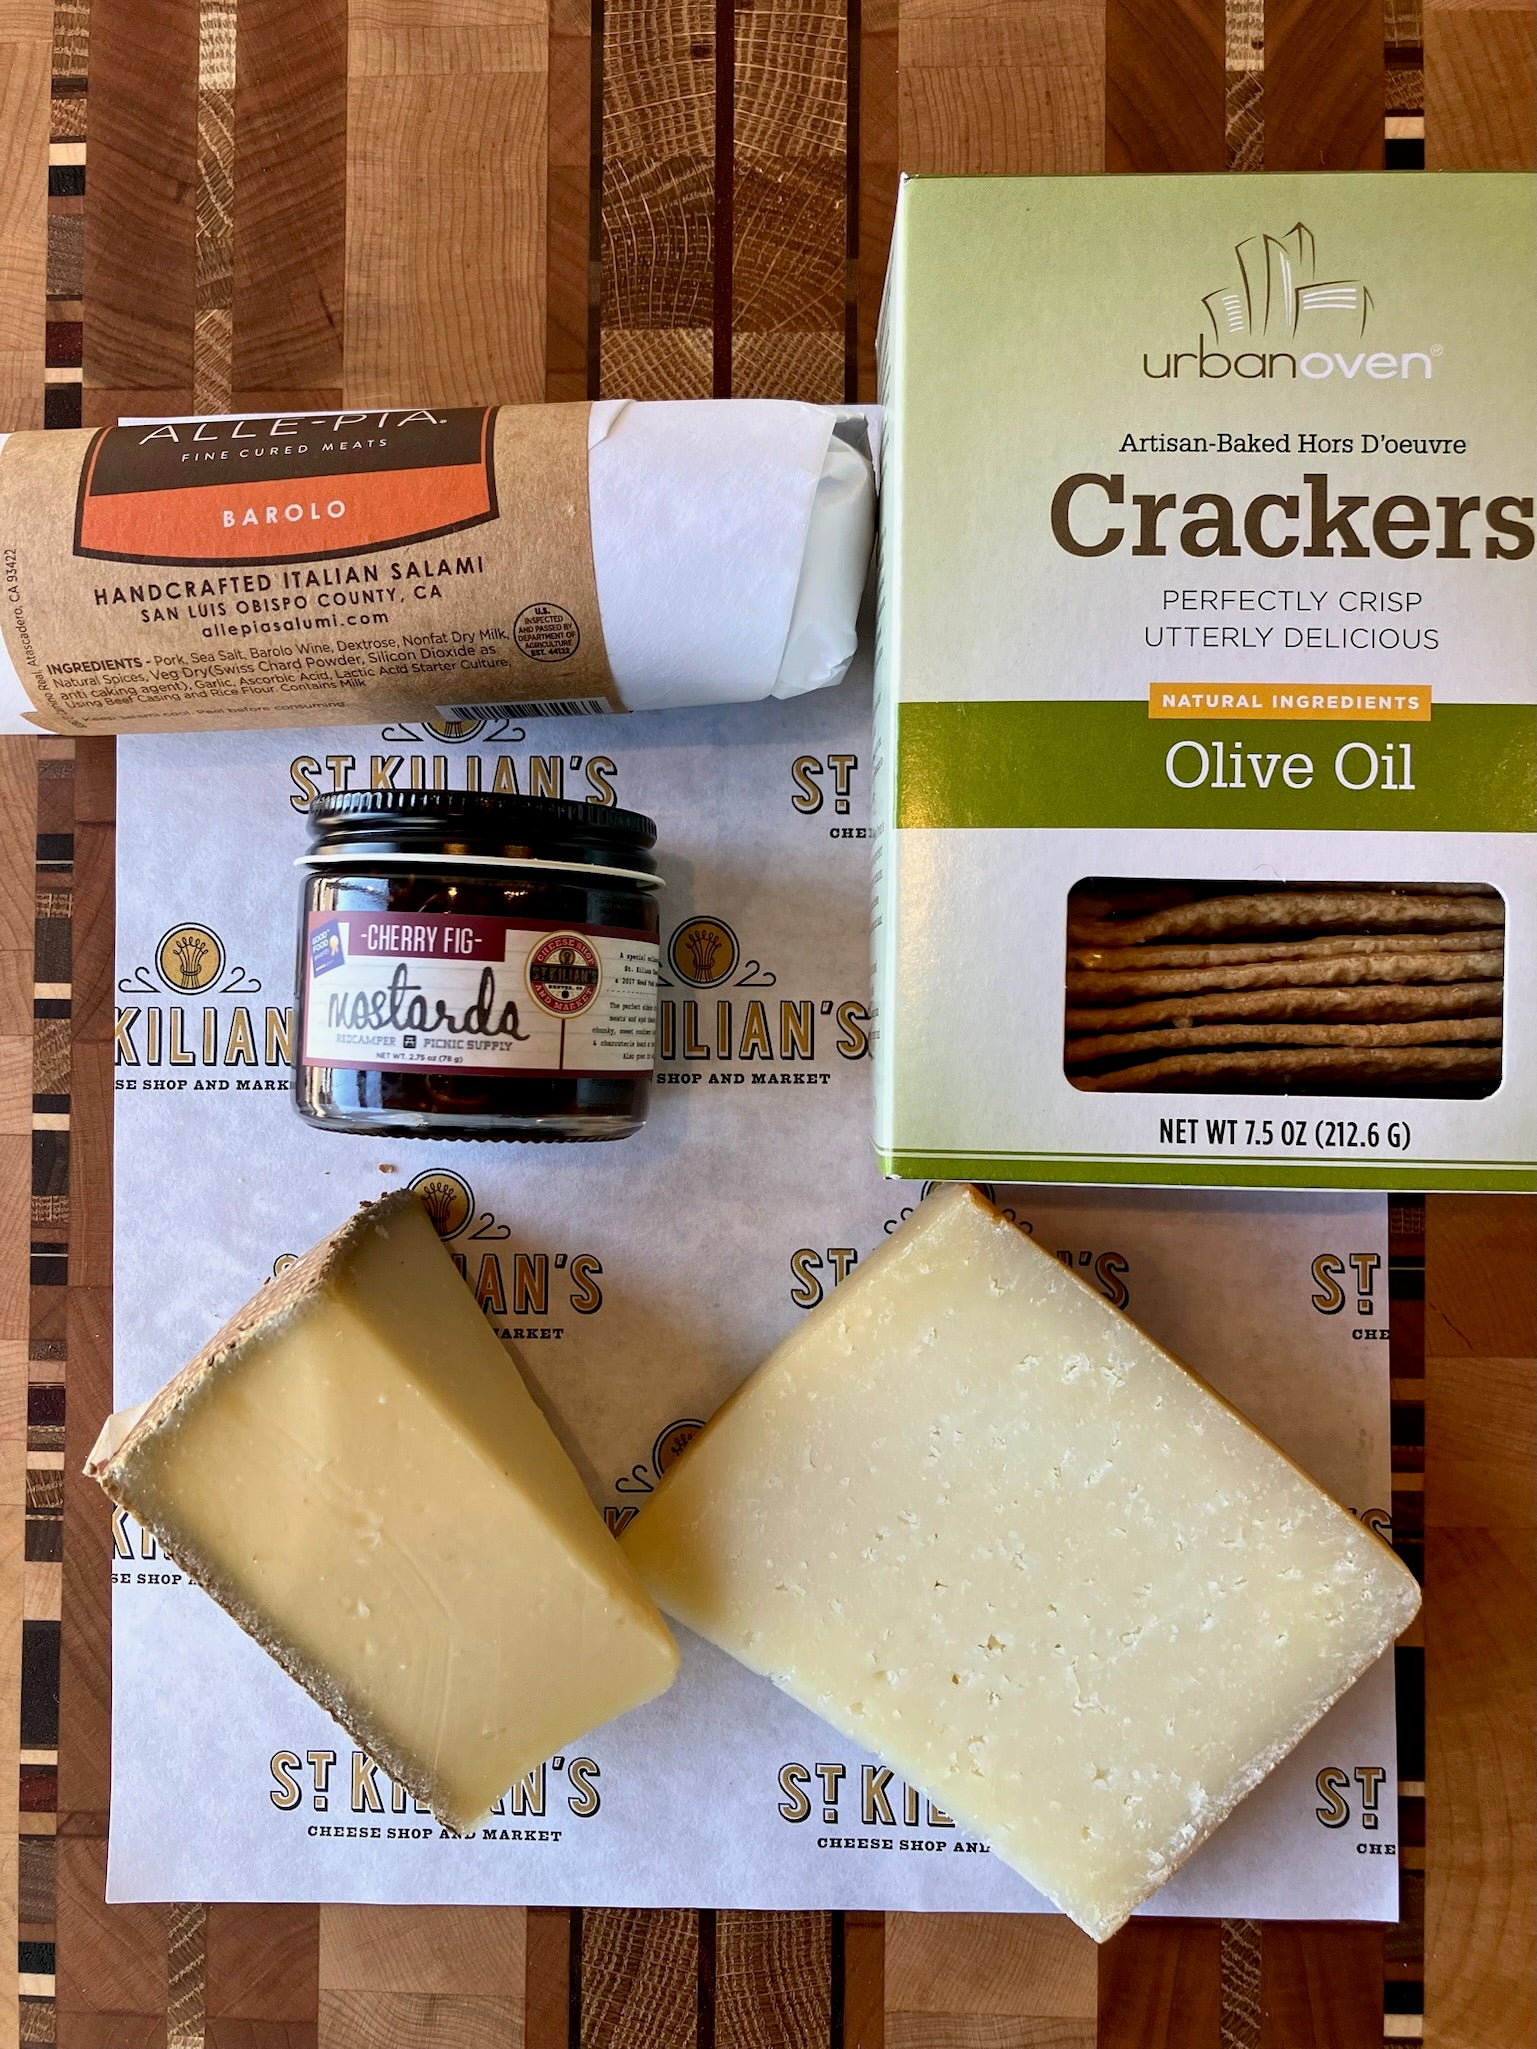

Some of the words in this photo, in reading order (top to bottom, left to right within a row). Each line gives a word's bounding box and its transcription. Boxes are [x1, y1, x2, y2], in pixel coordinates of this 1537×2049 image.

[181, 450, 229, 463] FINE
[239, 444, 309, 459] CURED
[321, 438, 388, 452] MEATS
[1119, 433, 1290, 454] Artisan-Baked
[1298, 434, 1353, 454] Hors
[1361, 435, 1466, 455] D'oeuvre
[223, 500, 346, 528] BAROLO
[1050, 472, 1536, 560] Crackers
[4, 549, 17, 582] 93422
[94, 574, 271, 606] HANDCRAFTED
[283, 564, 378, 589] ITALIAN
[391, 556, 484, 580] SALAMI
[8, 586, 20, 602] CA
[141, 606, 179, 623] SAN
[188, 603, 227, 619] LUIS
[236, 595, 307, 614] OBISPO
[317, 588, 405, 607] COUNTY,
[414, 585, 442, 600] CA
[1163, 590, 1328, 612] PERFECTLY
[1339, 591, 1422, 613] CRISP
[202, 612, 389, 638] allepiasalumi.com
[525, 615, 563, 624] INSPECTED
[535, 624, 561, 632] PASSED
[518, 632, 564, 641] DEPARTMENT
[1145, 626, 1273, 648] UTTERLY
[1285, 627, 1439, 650] DELICIOUS
[46, 657, 143, 675] INGREDIENTS
[153, 654, 189, 667] Pork,
[190, 652, 215, 664] Sea
[219, 649, 247, 661] Salt,
[250, 645, 293, 659] Barolo
[295, 642, 334, 655] Wine,
[336, 638, 400, 652] Dextrose,
[402, 632, 448, 647] Nonfat
[452, 631, 475, 644] Dry
[52, 676, 100, 689] Natural
[102, 672, 149, 687] Spices,
[150, 669, 179, 682] Veg
[258, 658, 303, 672] Chard
[305, 653, 365, 669] Powder,
[369, 650, 416, 664] Silicon
[420, 645, 475, 660] Dioxide
[480, 645, 497, 655] as
[61, 689, 87, 701] anti
[90, 685, 137, 699] caking
[141, 681, 193, 696] agent),
[239, 673, 296, 686] Ascorbic
[300, 670, 333, 682] Acid,
[334, 666, 375, 680] Lactic
[412, 661, 456, 673] Starter
[65, 698, 103, 710] Using
[105, 694, 134, 706] Beef
[137, 692, 180, 704] Casing
[184, 689, 207, 700] and
[211, 687, 239, 697] Rice
[280, 680, 338, 693] Contains
[340, 677, 367, 688] Milk
[1162, 694, 1263, 709] NATURAL
[1272, 695, 1420, 711] INGREDIENTS
[1165, 740, 1314, 789] Olive
[1334, 742, 1416, 791] Oil
[537, 939, 575, 962] CHEESE
[424, 1037, 465, 1050] PICNIC
[467, 1039, 514, 1052] SUPPLY
[377, 1052, 390, 1060] NET
[409, 1053, 425, 1062] 2.75
[143, 1080, 188, 1090] SHOP
[194, 1080, 230, 1090] AND
[657, 1073, 703, 1085] SHOP
[709, 1073, 745, 1085] AND
[752, 1073, 831, 1085] MARKET
[1160, 1118, 1198, 1144] NET
[1206, 1119, 1238, 1145] WT
[1245, 1119, 1274, 1146] 7.5
[1280, 1120, 1308, 1147] OZ
[1315, 1120, 1380, 1150] (212.6
[1387, 1121, 1412, 1151] G)
[137, 1573, 182, 1585] SHOP
[308, 1825, 381, 1839] CHEESE
[387, 1827, 433, 1840] SHOP
[483, 1829, 562, 1842] MARKET
[817, 1837, 893, 1850] CHEESE
[900, 1839, 947, 1852] SHOP
